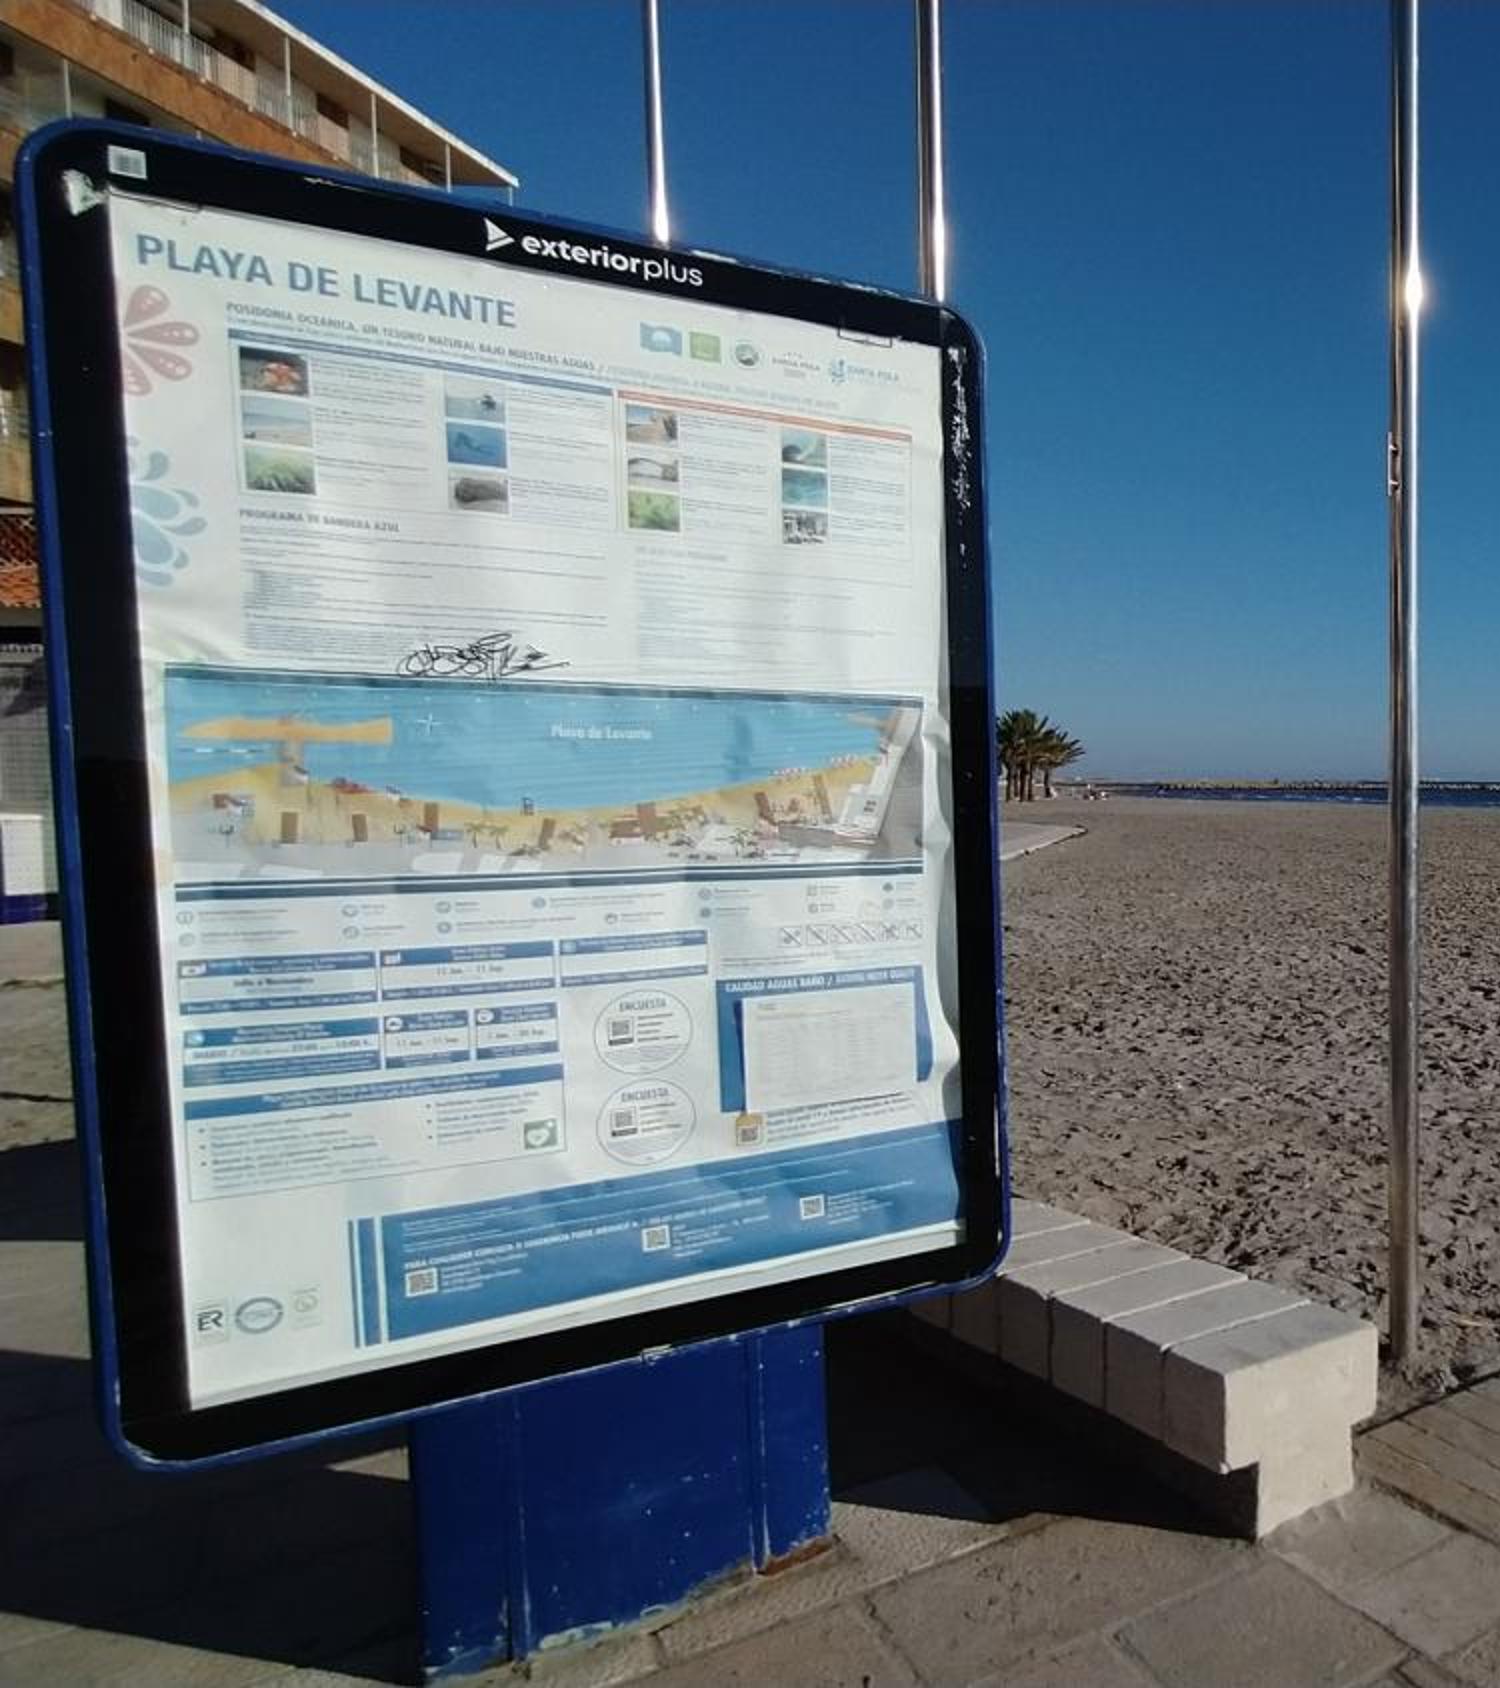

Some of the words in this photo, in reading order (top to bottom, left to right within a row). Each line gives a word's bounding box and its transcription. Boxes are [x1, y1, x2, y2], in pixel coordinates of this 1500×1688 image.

[136, 233, 273, 287] PLAYA
[287, 261, 340, 297] DE
[353, 273, 517, 328] LEVANTE
[520, 234, 704, 287] exteriorplus
